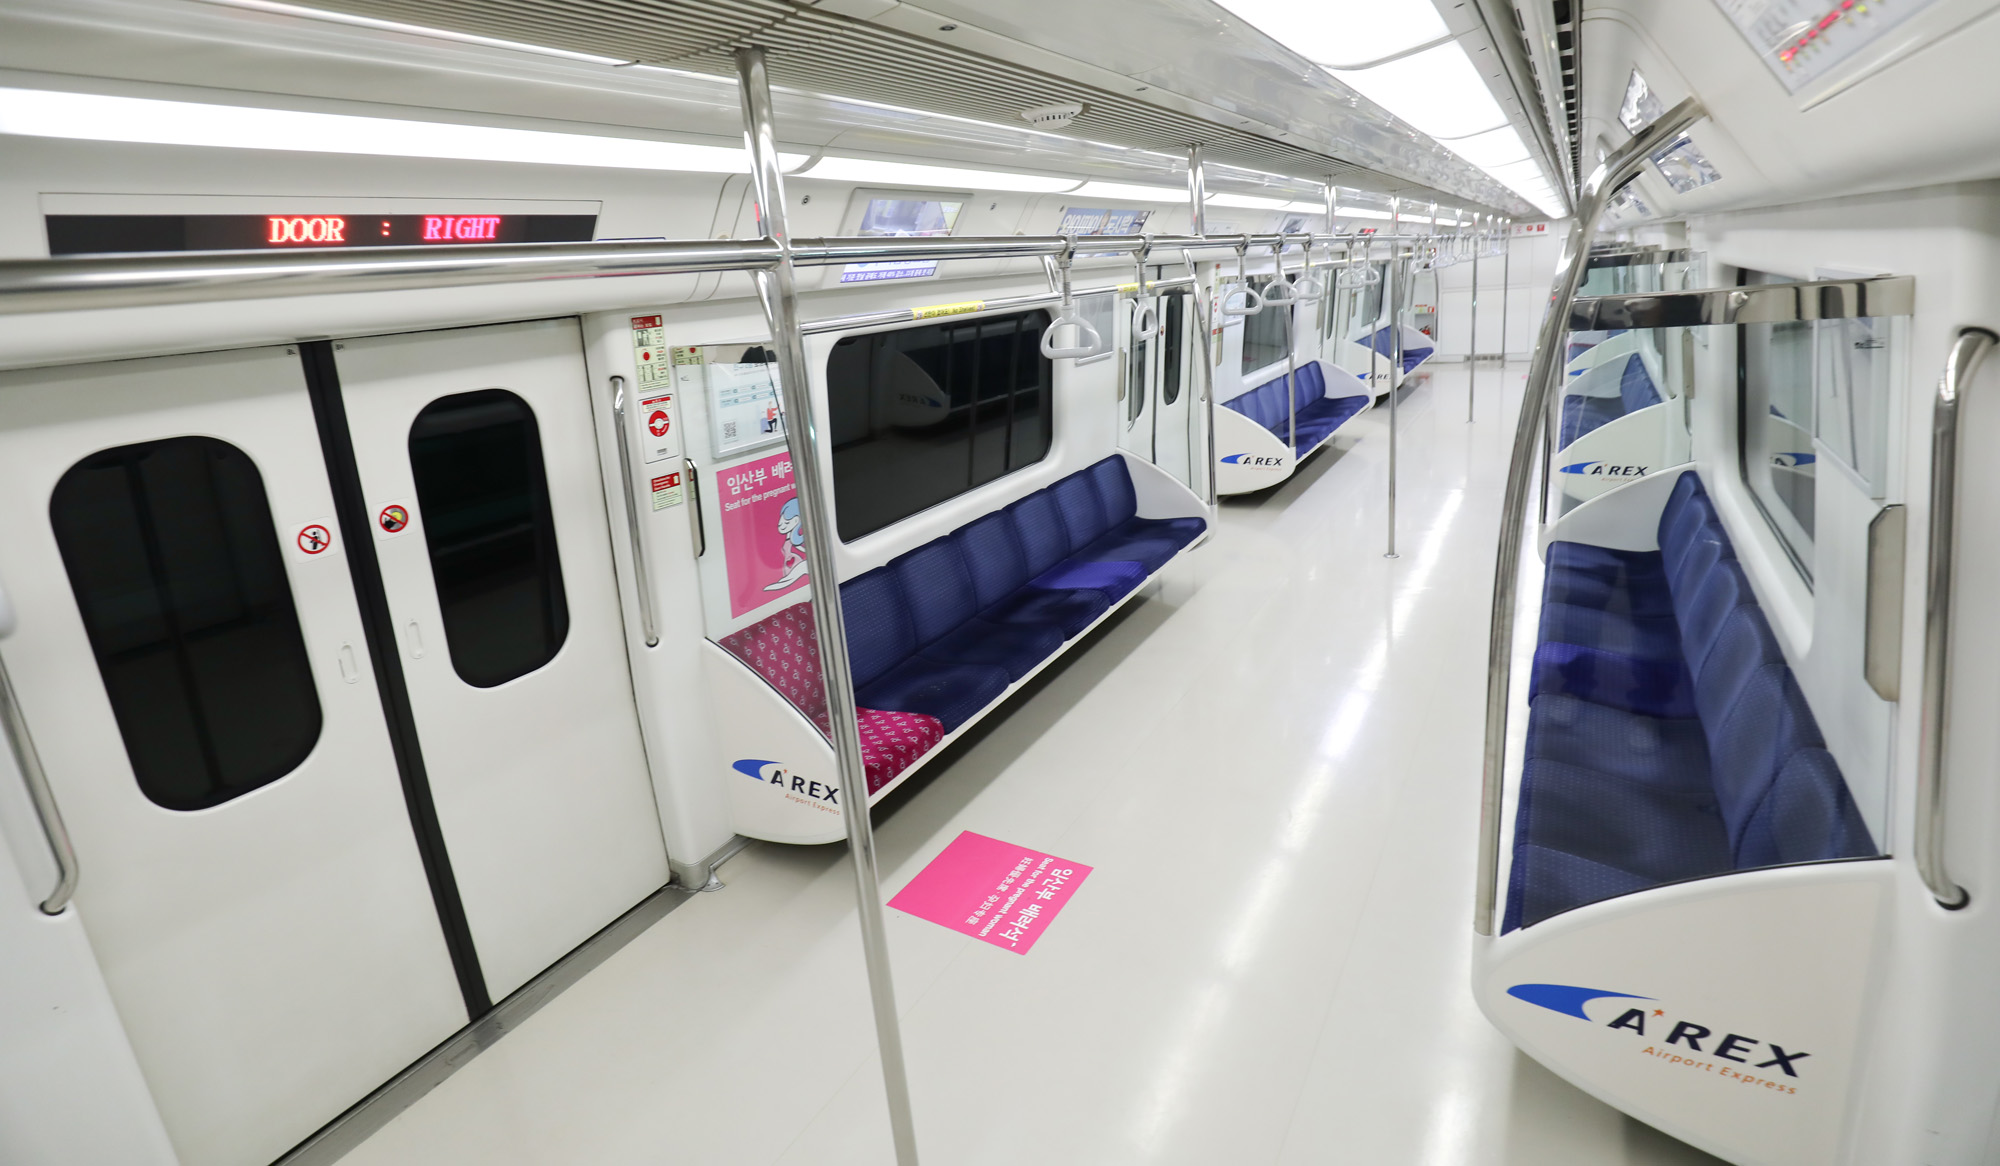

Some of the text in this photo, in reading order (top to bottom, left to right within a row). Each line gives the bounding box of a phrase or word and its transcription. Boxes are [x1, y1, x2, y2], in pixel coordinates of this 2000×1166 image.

[268, 217, 345, 243] DOOR
[423, 217, 501, 240] RIGHT
[1243, 456, 1283, 467] AREX
[1591, 465, 1648, 477] AREX
[727, 467, 768, 496] 임산부
[725, 500, 741, 511] Seat
[741, 497, 751, 507] for
[751, 493, 763, 503] the
[763, 483, 791, 501] pregnant
[770, 769, 840, 805] AREX
[785, 793, 840, 816] Airport Express
[978, 857, 1054, 937] Seat for the pregnant woman
[998, 868, 1073, 942] 임산부 배려석
[1607, 1008, 1811, 1078] AREX
[1642, 1046, 1797, 1095] Airport Express
